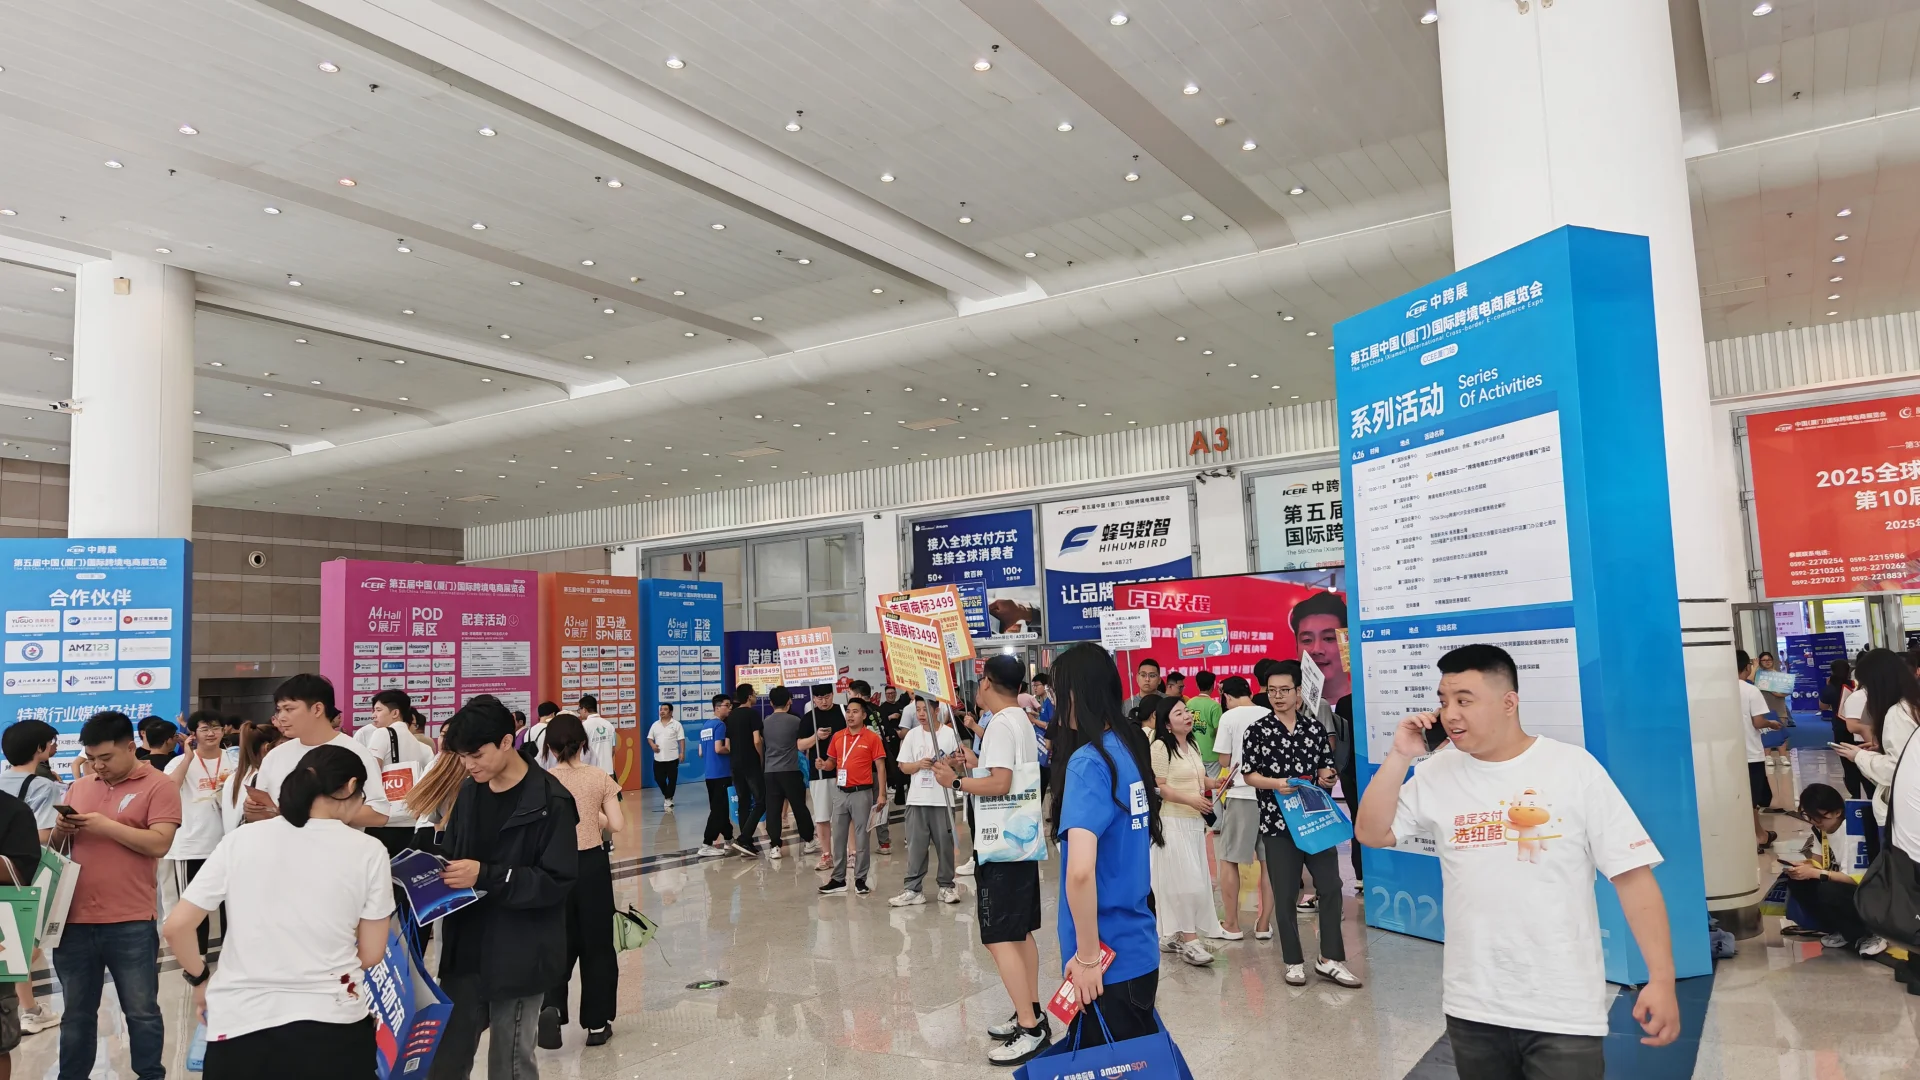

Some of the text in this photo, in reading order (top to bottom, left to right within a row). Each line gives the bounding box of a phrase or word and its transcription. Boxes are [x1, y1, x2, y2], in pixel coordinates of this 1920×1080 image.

[1406, 282, 1468, 318] ICEIE 中跨展
[1370, 358, 1384, 366] China
[1408, 335, 1444, 352] International
[1446, 319, 1484, 338] Cross-border
[1486, 305, 1525, 323] E-commerce
[1528, 299, 1543, 310] Expo
[1458, 367, 1498, 389] Series
[1460, 373, 1542, 408] Of Activities
[1351, 382, 1444, 439] 系列活动
[1189, 427, 1229, 456] A3
[1352, 451, 1365, 461] 6.26
[1370, 447, 1379, 455] 时间
[1424, 429, 1444, 441] 活动名称
[1816, 461, 1920, 488] 2025全球
[1282, 486, 1308, 496] ICEIE
[1058, 508, 1079, 516] ICEIE
[1101, 518, 1171, 542] 蜂鸟数智
[928, 529, 1018, 551] 接入全球支付方式
[1099, 538, 1167, 553] HIHUMBIRD
[88, 546, 116, 554] 中跨展
[932, 546, 1014, 566] 连接全球消费者
[1790, 553, 1905, 567] 0592-2270254 0592-2215986
[964, 570, 983, 579] 数百种
[1003, 567, 1022, 576] 100+
[1791, 562, 1906, 577] 0592-2210265 0592-2270262
[1792, 572, 1906, 586] 0592-2270273 0592-2218831
[49, 588, 132, 607] 合作伙伴
[368, 606, 401, 620] A4 Hall
[412, 607, 443, 621] POD
[462, 613, 507, 626] 配套活动
[378, 621, 400, 633] 展厅
[564, 616, 574, 627] A3
[596, 616, 626, 628] 亚马逊
[668, 618, 676, 628] A5
[694, 619, 710, 629] 卫浴
[412, 622, 438, 636] 展区
[572, 628, 588, 638] 展厅
[596, 630, 632, 640] SPN展区
[674, 630, 688, 638] 展厅
[695, 630, 711, 641] 展区
[884, 620, 937, 644] 美国商标3499
[1361, 629, 1375, 639] 6.27
[780, 632, 829, 646] 东南亚双清到门
[1454, 810, 1503, 826] 稳定交付
[1454, 825, 1503, 844] 选纽酷
[1100, 1060, 1148, 1076] amazon spn
